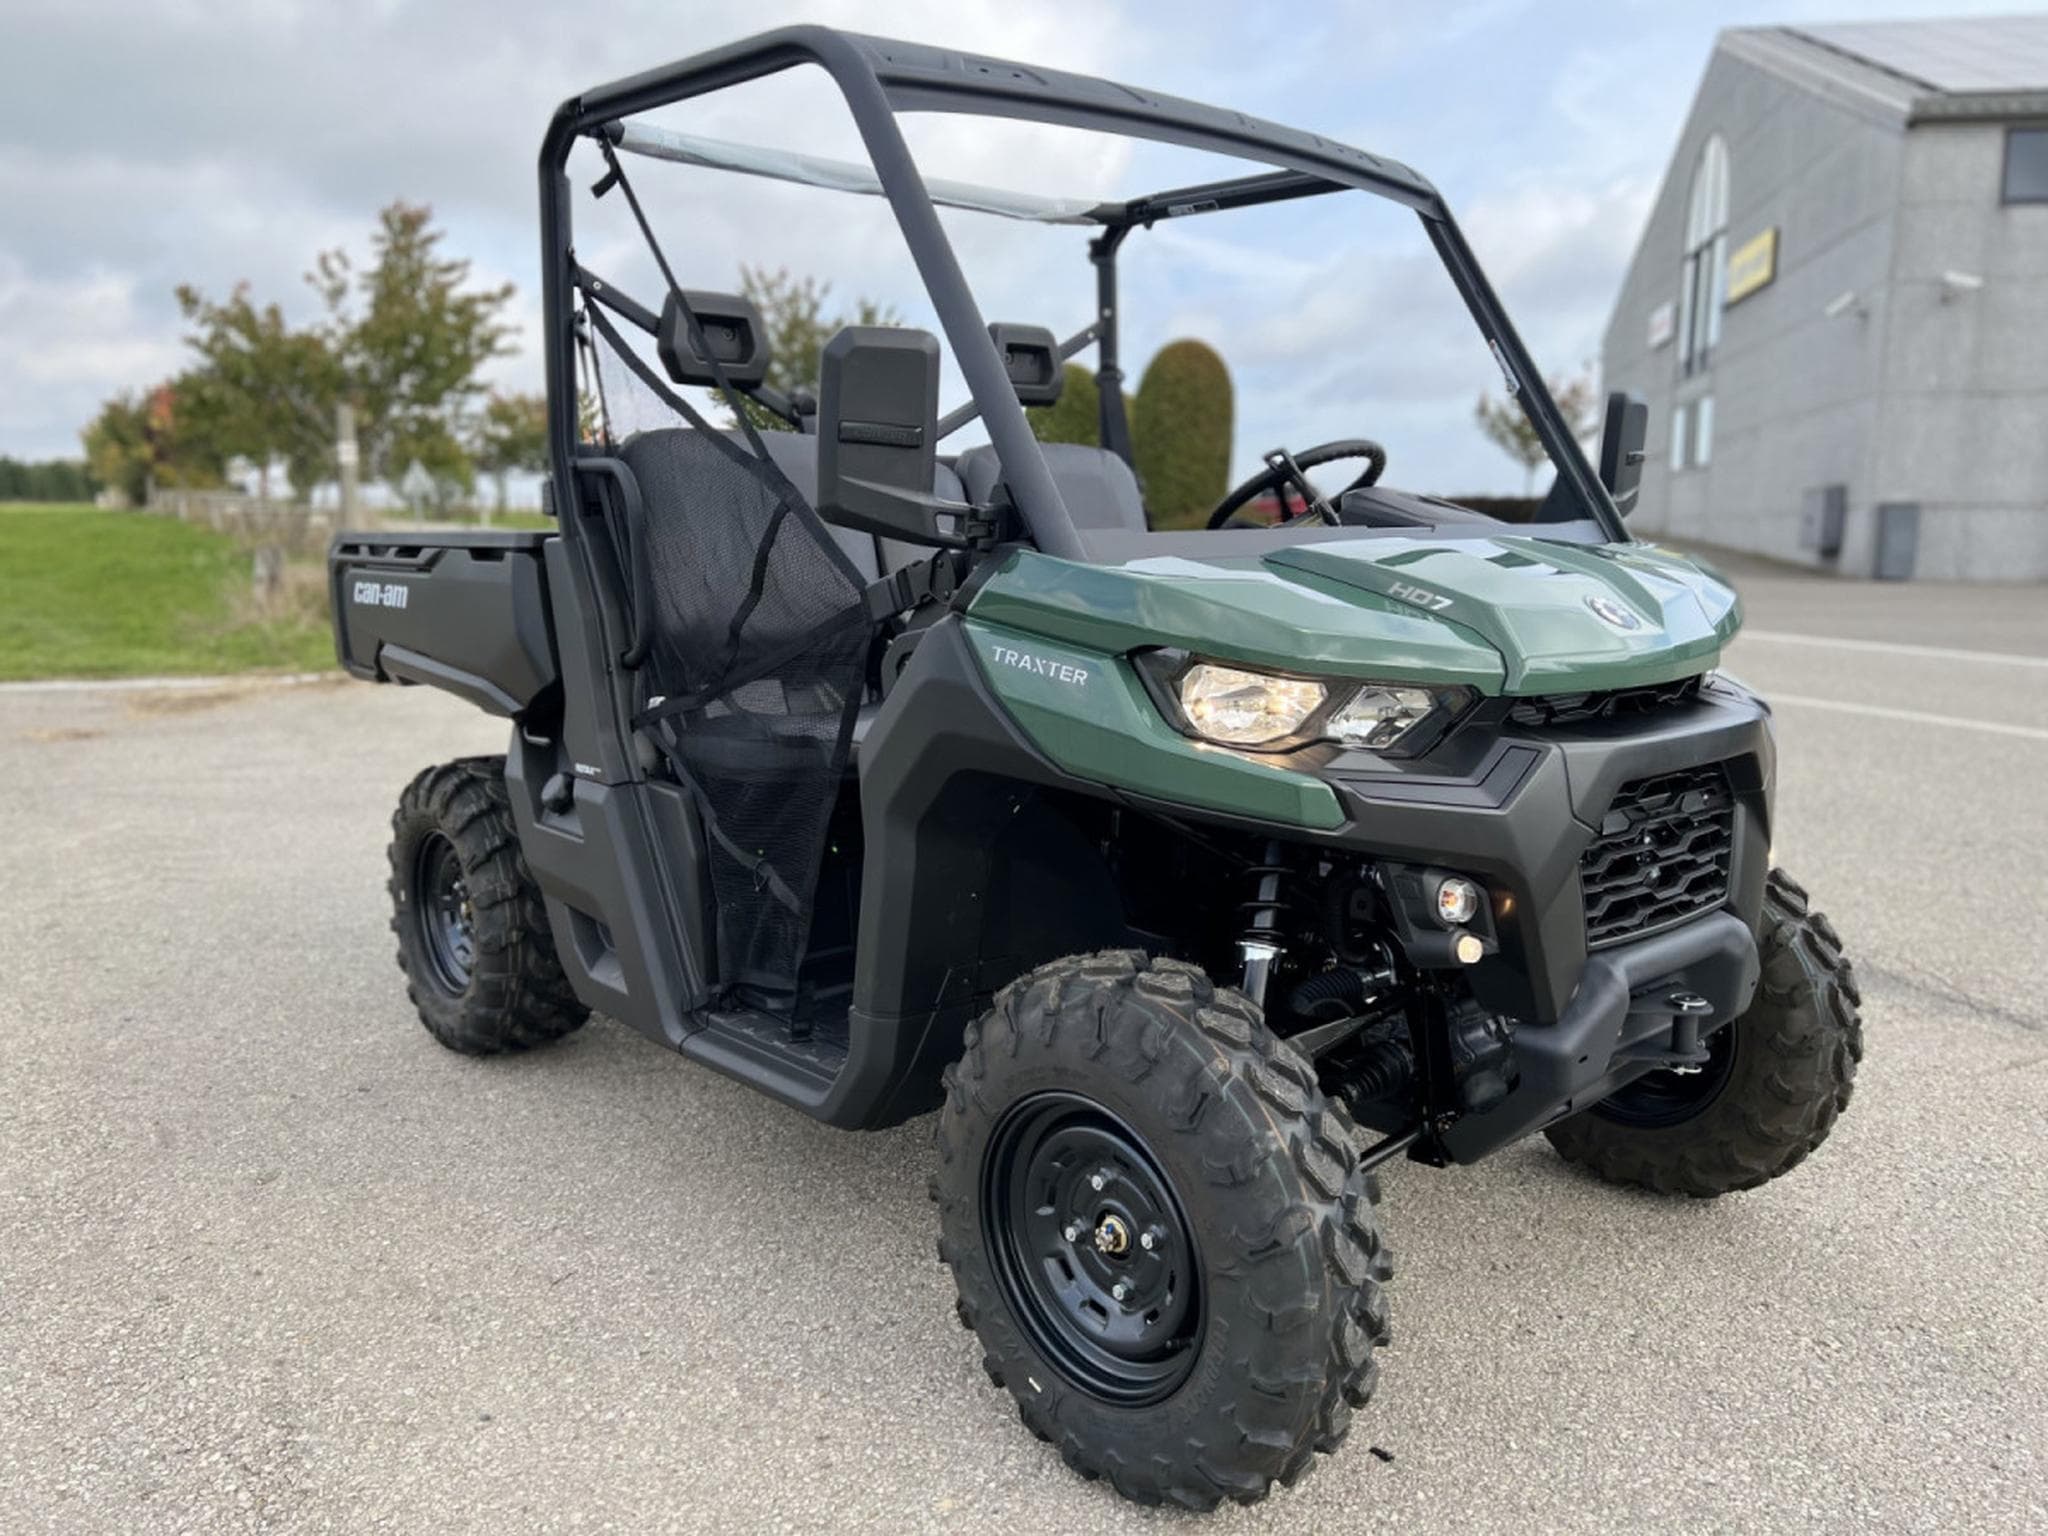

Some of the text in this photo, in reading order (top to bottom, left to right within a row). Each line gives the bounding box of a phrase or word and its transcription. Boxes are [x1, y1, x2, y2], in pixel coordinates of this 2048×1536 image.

[353, 581, 408, 609] can-am
[1388, 582, 1454, 610] HD7
[992, 646, 1089, 686] TRAXTER
